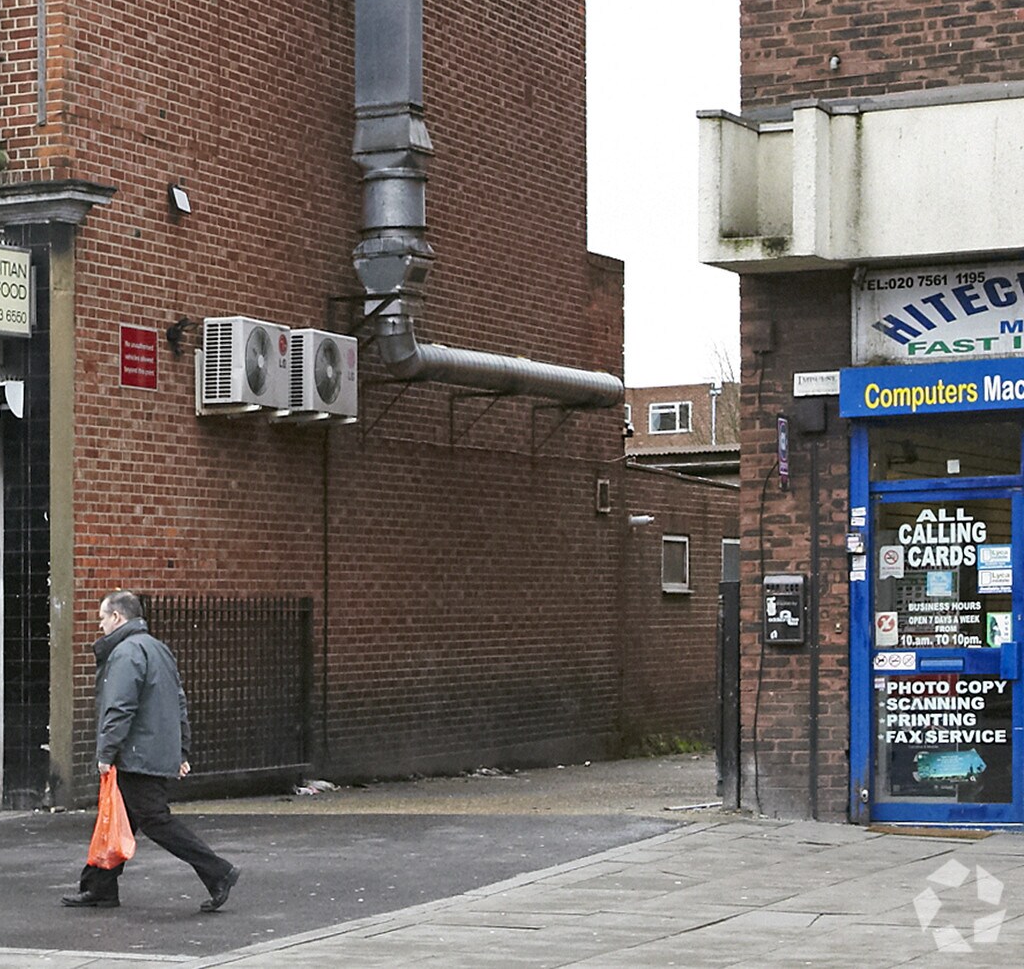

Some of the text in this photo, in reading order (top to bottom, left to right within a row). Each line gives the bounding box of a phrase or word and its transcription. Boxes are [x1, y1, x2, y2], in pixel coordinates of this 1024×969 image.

[917, 274, 948, 287] 7561
[956, 271, 986, 285] 1195
[6, 309, 27, 325] 6550
[908, 337, 999, 356] FAST
[279, 358, 286, 368] LG
[864, 379, 978, 413] Computers
[916, 507, 974, 522] ALL
[898, 521, 987, 545] CALLING
[907, 545, 977, 568] CARDS
[908, 601, 981, 612] BUSINESS HOURS
[908, 615, 980, 625] OPEN 7 DAYS A WEEK
[935, 625, 958, 633] FROM
[935, 634, 949, 645] TO
[887, 680, 1007, 695] PHOTO COPY
[886, 696, 985, 711] SCANNING
[887, 713, 977, 727] PRINTING
[886, 729, 1007, 744] FAX SERVICE
